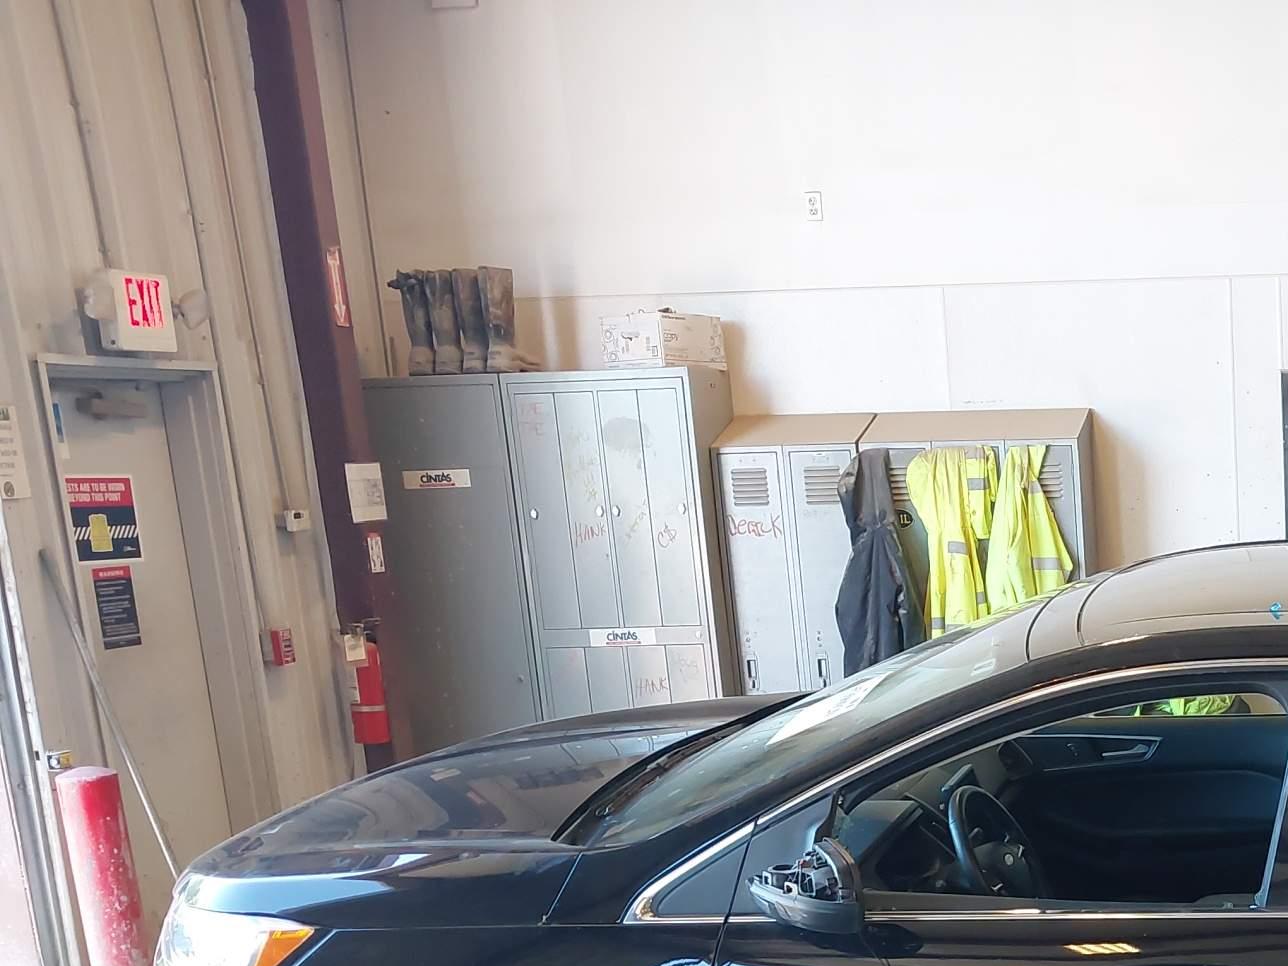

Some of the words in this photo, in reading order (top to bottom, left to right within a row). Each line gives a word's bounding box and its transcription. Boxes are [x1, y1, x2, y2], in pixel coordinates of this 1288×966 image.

[124, 277, 164, 328] EXIT
[420, 472, 452, 483] CINTAS
[606, 630, 638, 642] CINTAS
